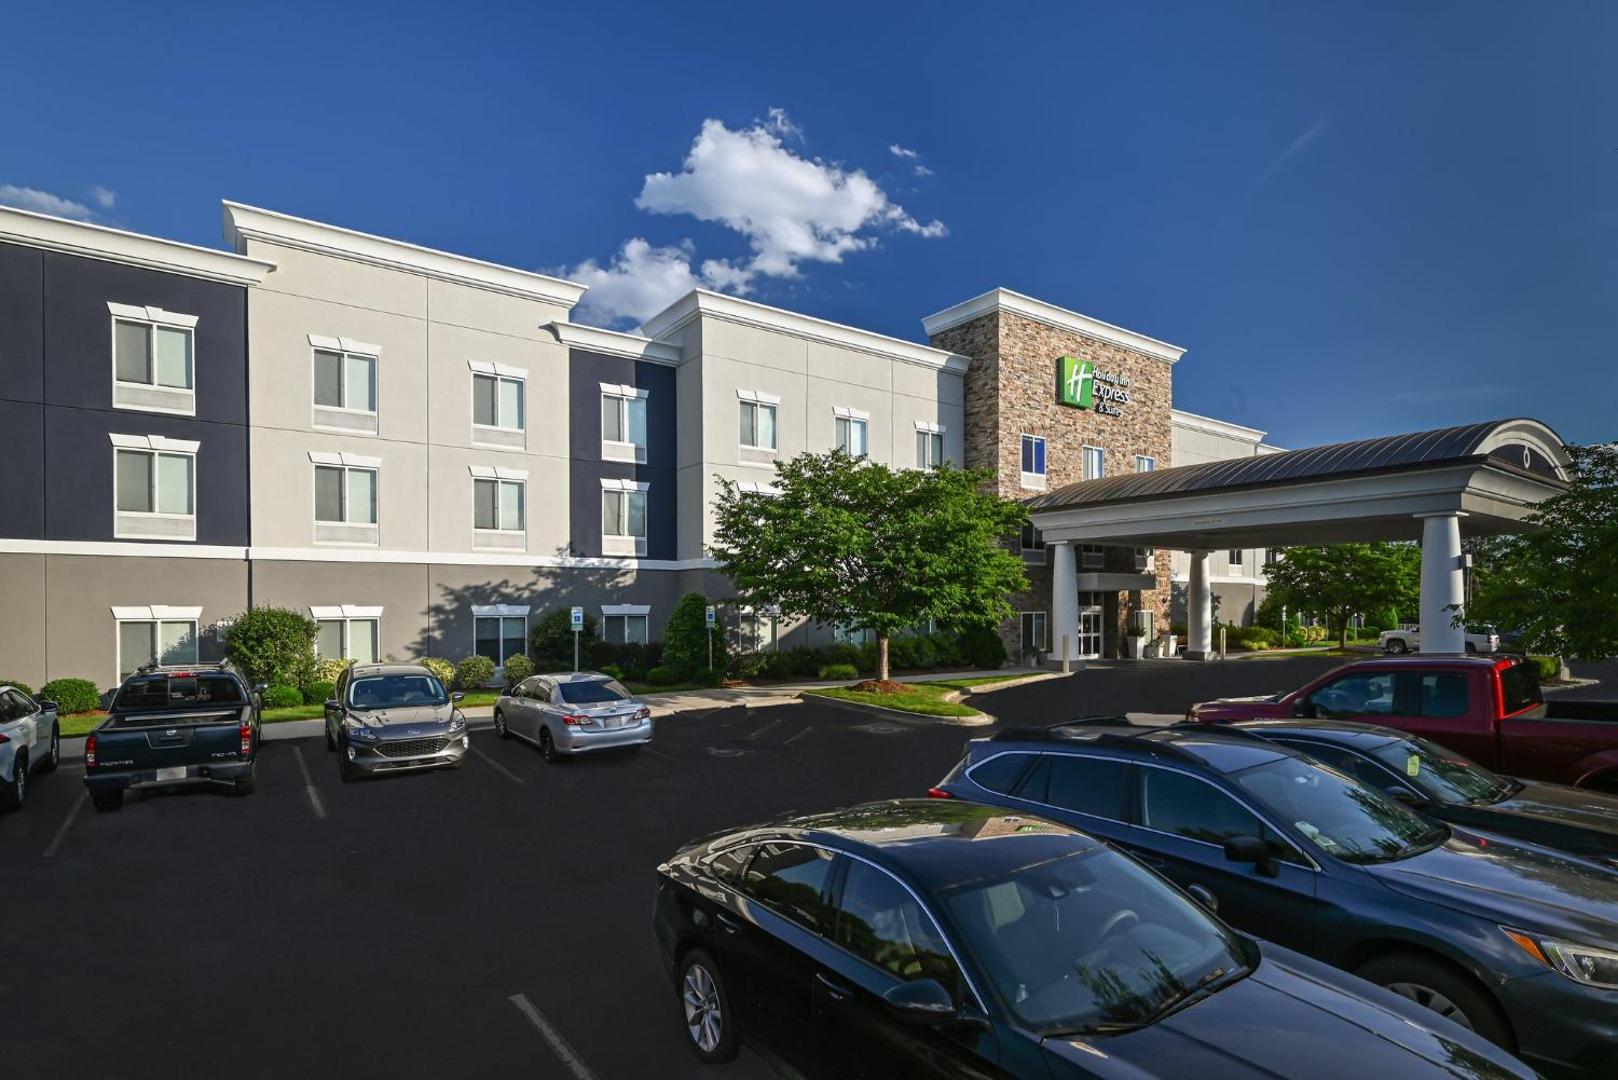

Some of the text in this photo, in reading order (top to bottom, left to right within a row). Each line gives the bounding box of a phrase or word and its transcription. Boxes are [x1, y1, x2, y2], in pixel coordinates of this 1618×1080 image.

[1067, 364, 1092, 402] H
[1092, 366, 1130, 386] Holiday Inn
[1092, 380, 1130, 404] Express
